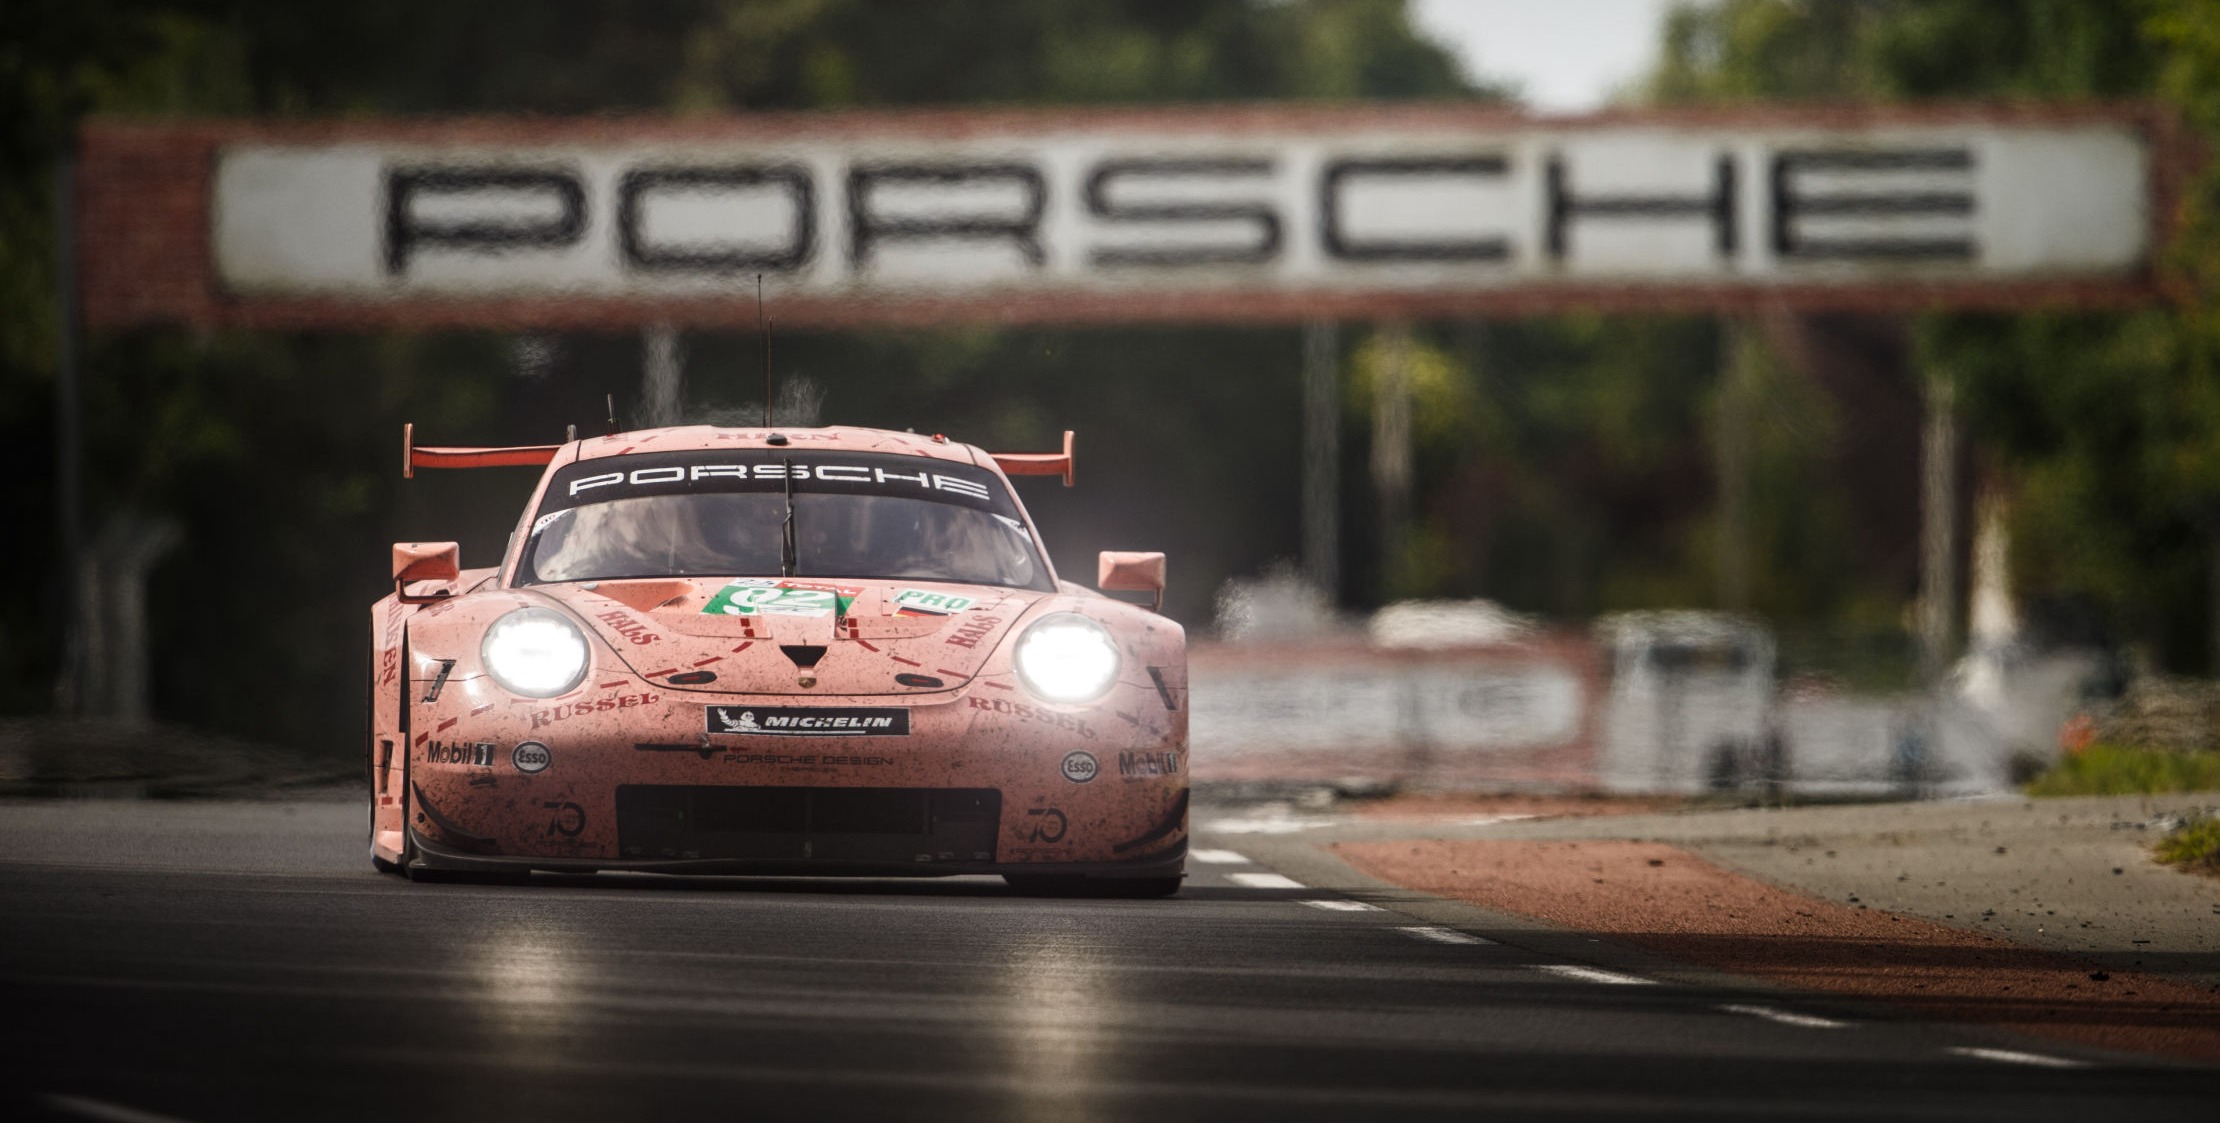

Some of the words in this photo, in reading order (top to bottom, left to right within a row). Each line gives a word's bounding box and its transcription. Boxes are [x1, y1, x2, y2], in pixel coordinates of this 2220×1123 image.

[383, 149, 1977, 274] PORSCHE
[569, 464, 990, 500] PORSCHE
[723, 587, 837, 615] 92
[901, 589, 971, 609] PRO
[595, 610, 662, 646] HALS
[944, 614, 1003, 650] HALS
[764, 716, 893, 728] MICHELIN
[427, 740, 472, 765] Mobil
[517, 749, 546, 764] Esso
[723, 754, 816, 765] PORSCHE
[823, 755, 894, 766] DESIGN
[1066, 759, 1093, 774] Esso
